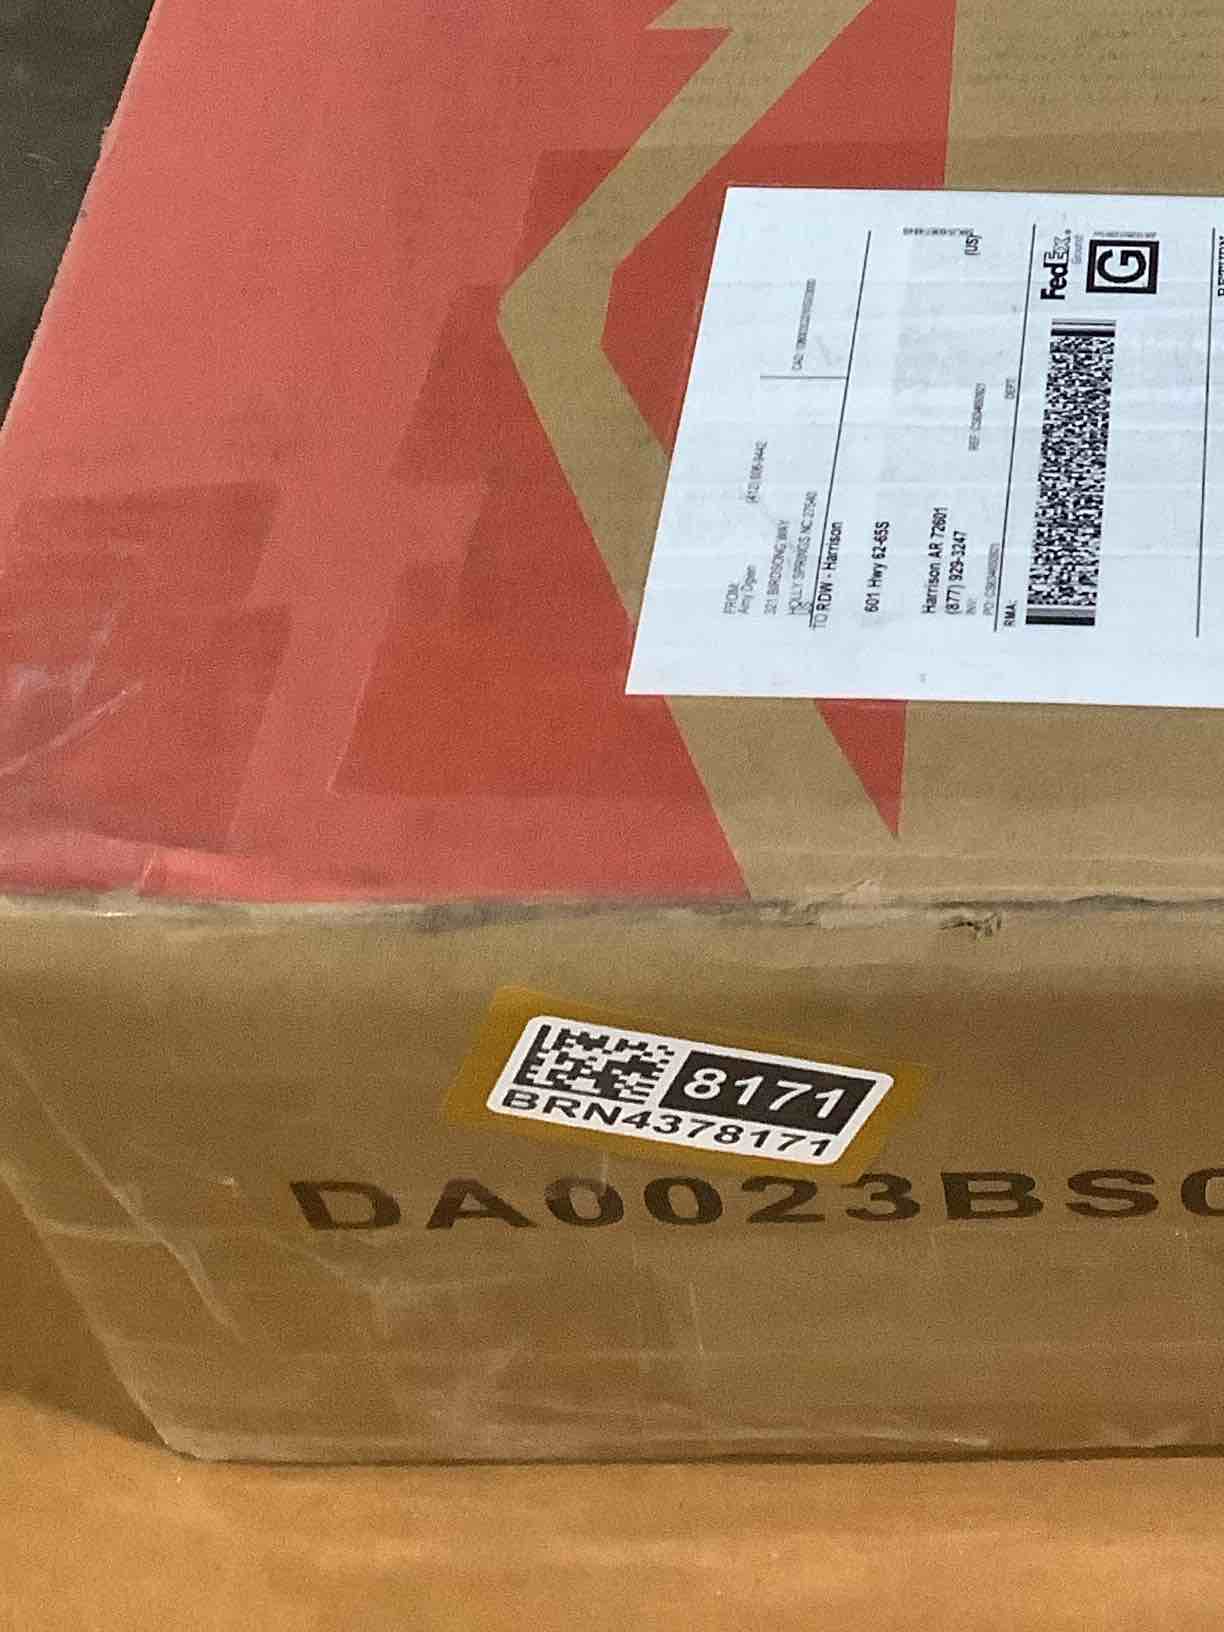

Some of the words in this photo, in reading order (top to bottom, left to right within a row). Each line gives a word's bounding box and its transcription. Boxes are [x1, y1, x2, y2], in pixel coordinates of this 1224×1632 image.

[963, 234, 982, 256] (US)
[930, 506, 948, 539] 72601
[820, 521, 843, 571] Harrison
[870, 521, 890, 559] 62-65S
[927, 543, 943, 559] AR
[947, 530, 967, 581] 929-3247
[866, 563, 888, 588] Hwy
[921, 562, 942, 615] Harrison
[816, 582, 834, 611] RDW
[864, 593, 880, 612] 601
[945, 584, 967, 615] (877)
[1003, 599, 1018, 627] RMA:
[684, 1068, 846, 1119] 8171
[500, 1088, 833, 1157] BRN4378171
